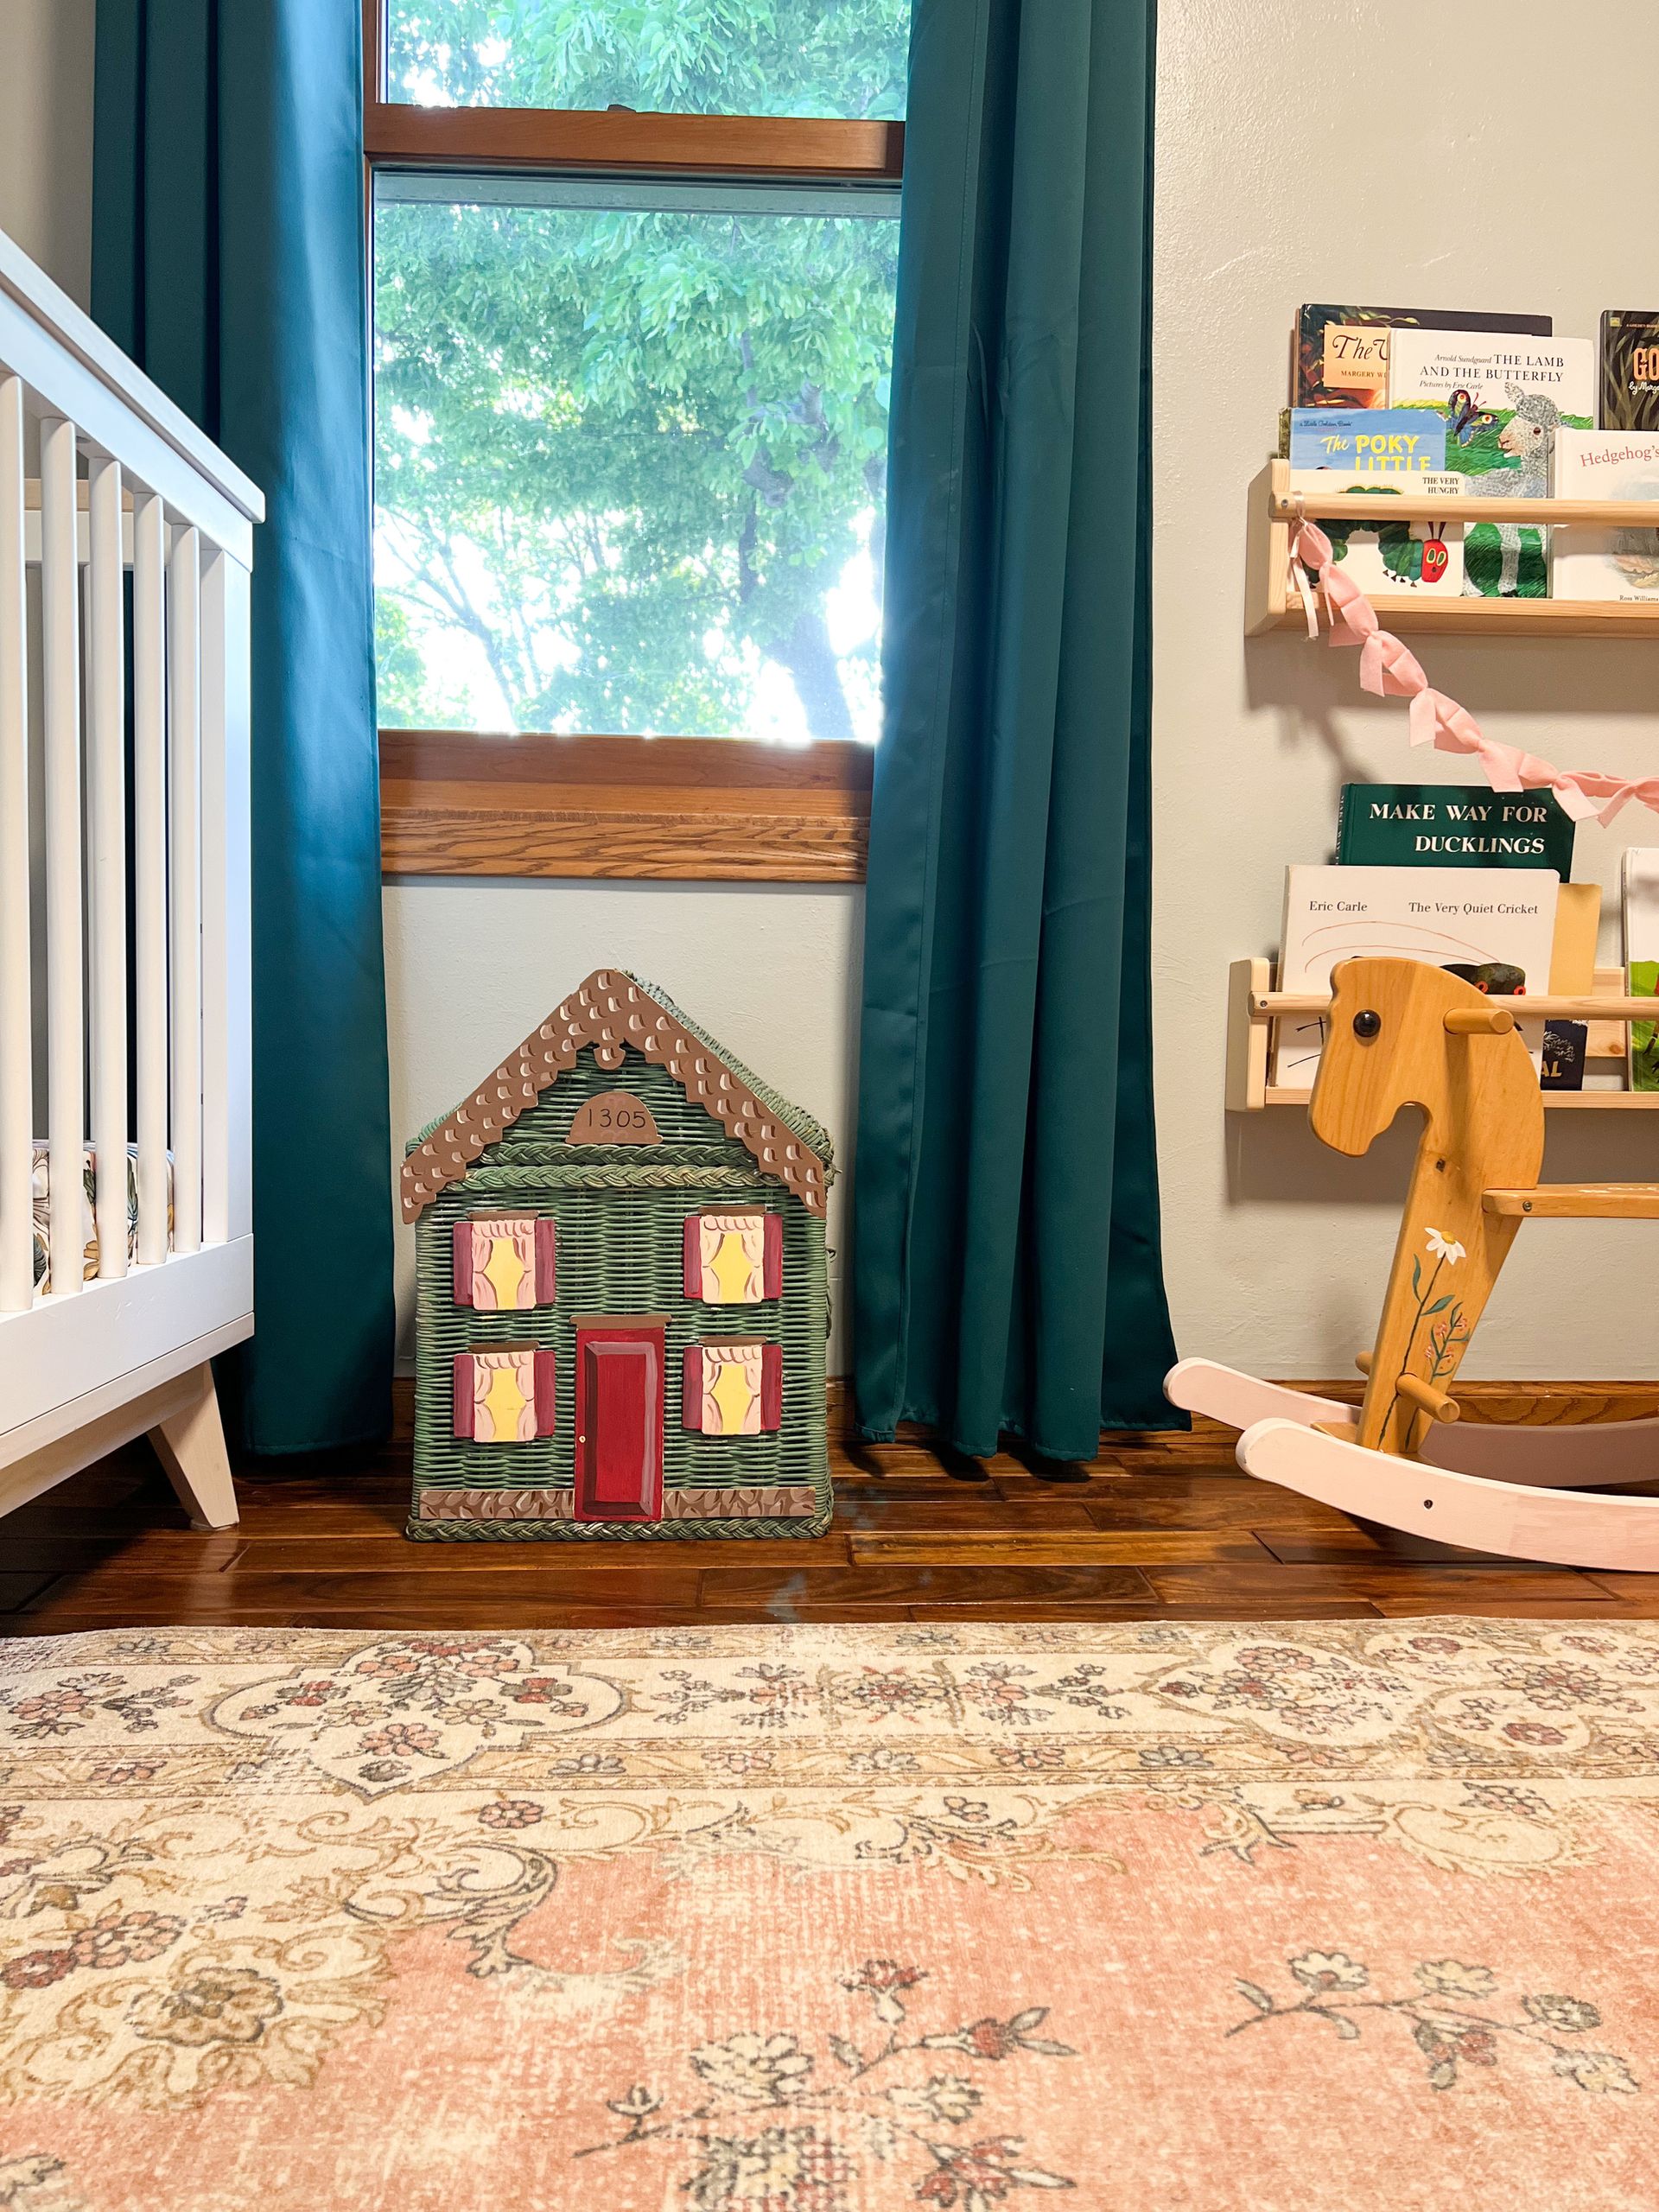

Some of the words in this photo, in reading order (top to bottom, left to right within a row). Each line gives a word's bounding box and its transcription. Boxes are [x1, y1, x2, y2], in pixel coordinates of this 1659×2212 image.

[1332, 334, 1373, 360] The
[1494, 354, 1522, 365] THE
[1527, 356, 1564, 367] LAMB
[1420, 366, 1449, 378] AND
[1453, 367, 1481, 378] THE
[1486, 369, 1564, 382] BUTTERFLY
[1444, 381, 1452, 391] by
[1628, 380, 1638, 395] by
[1320, 435, 1350, 454] The
[1355, 435, 1420, 454] POKY
[1427, 486, 1459, 495] HUNGRY
[1370, 803, 1436, 820] MAKE
[1446, 804, 1493, 822] WAY
[1502, 806, 1548, 823] FOR
[1415, 836, 1546, 855] DUCKLINGS
[1309, 901, 1333, 912] Eric
[1337, 901, 1368, 912] Carle
[1408, 902, 1431, 912] The
[1435, 903, 1459, 915] Very
[1463, 903, 1494, 915] Quiet
[1497, 903, 1539, 914] Cricket
[588, 1108, 646, 1128] 1305
